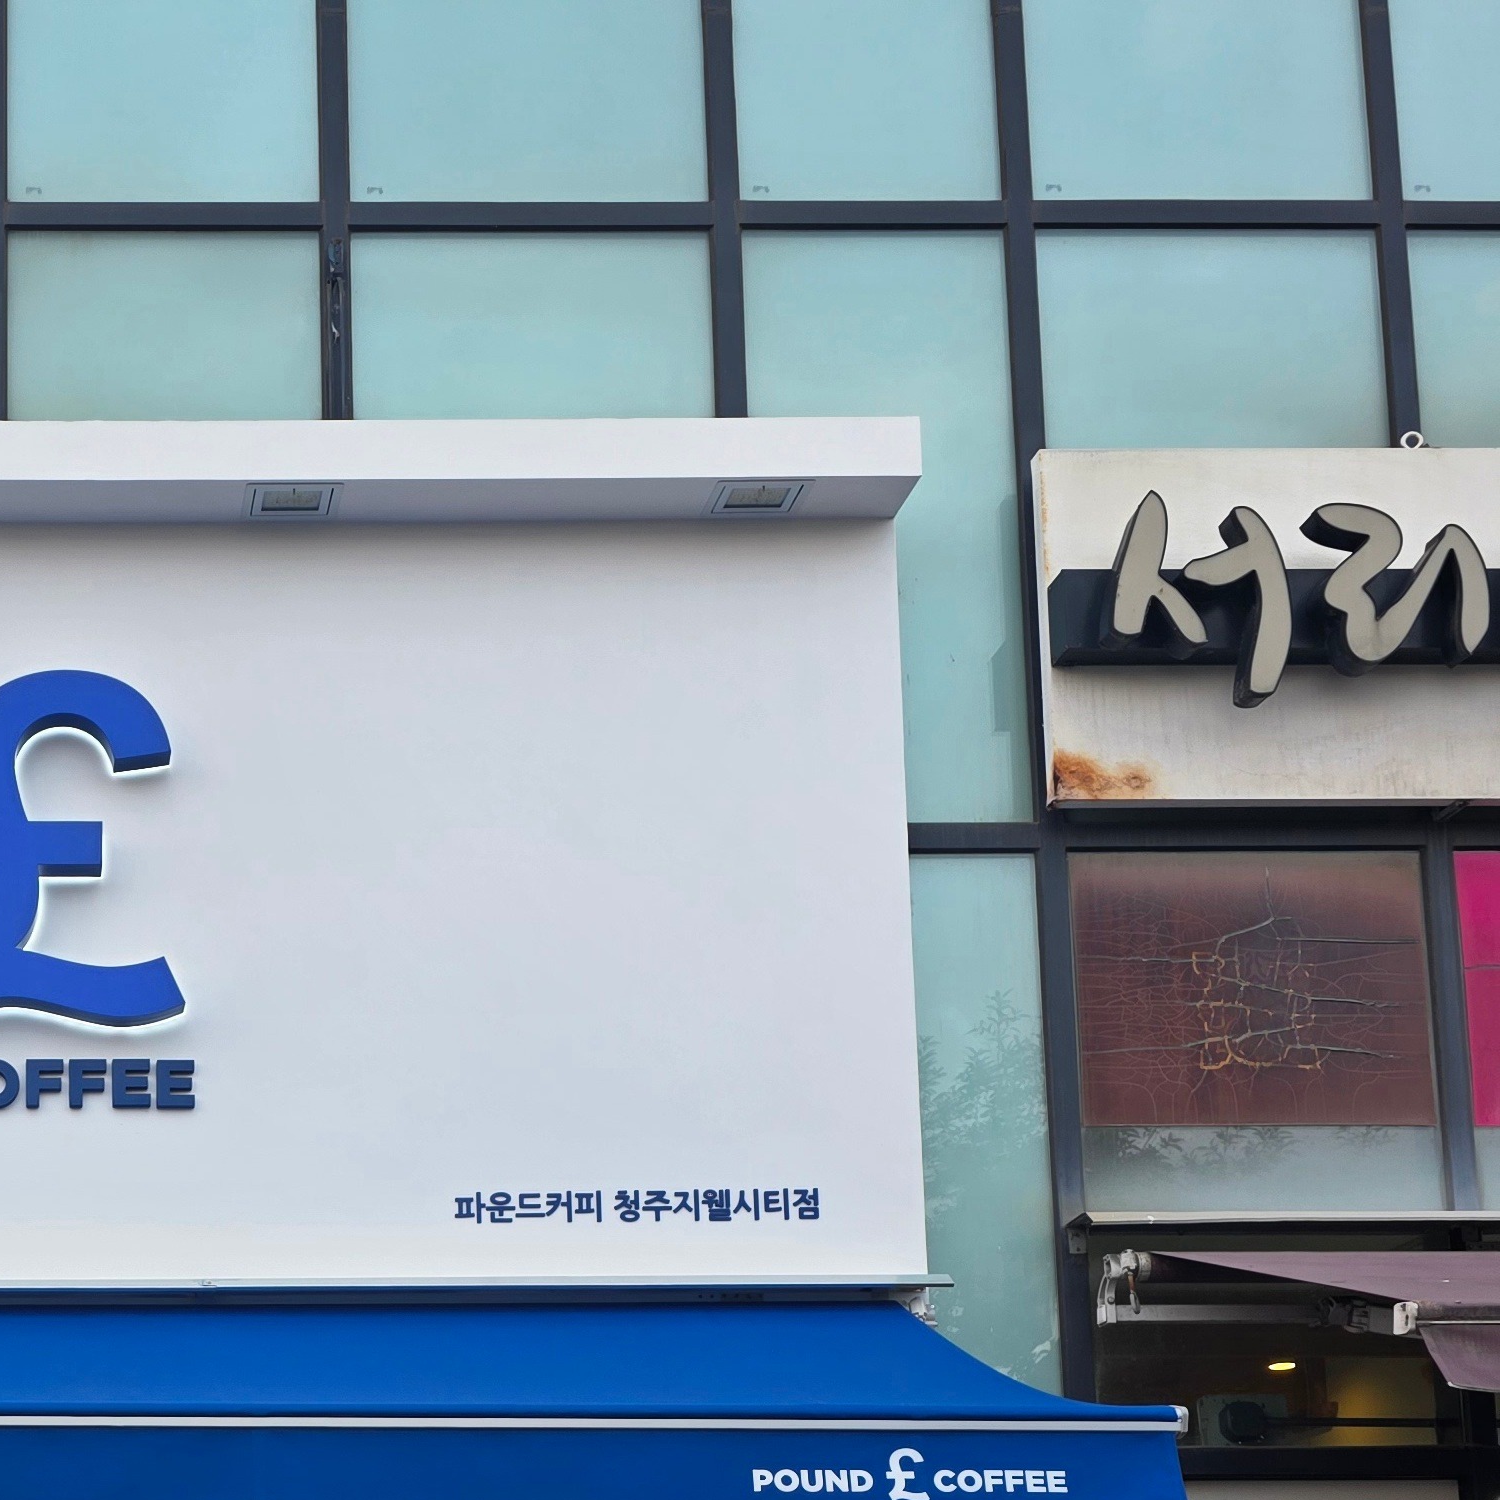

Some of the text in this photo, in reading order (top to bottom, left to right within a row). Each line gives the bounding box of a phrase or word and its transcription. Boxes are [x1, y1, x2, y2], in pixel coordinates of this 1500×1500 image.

[454, 1187, 820, 1224] 파운드커피 청주지웰시티점
[752, 1469, 874, 1492] POUND
[933, 1469, 1069, 1493] COFFEE
